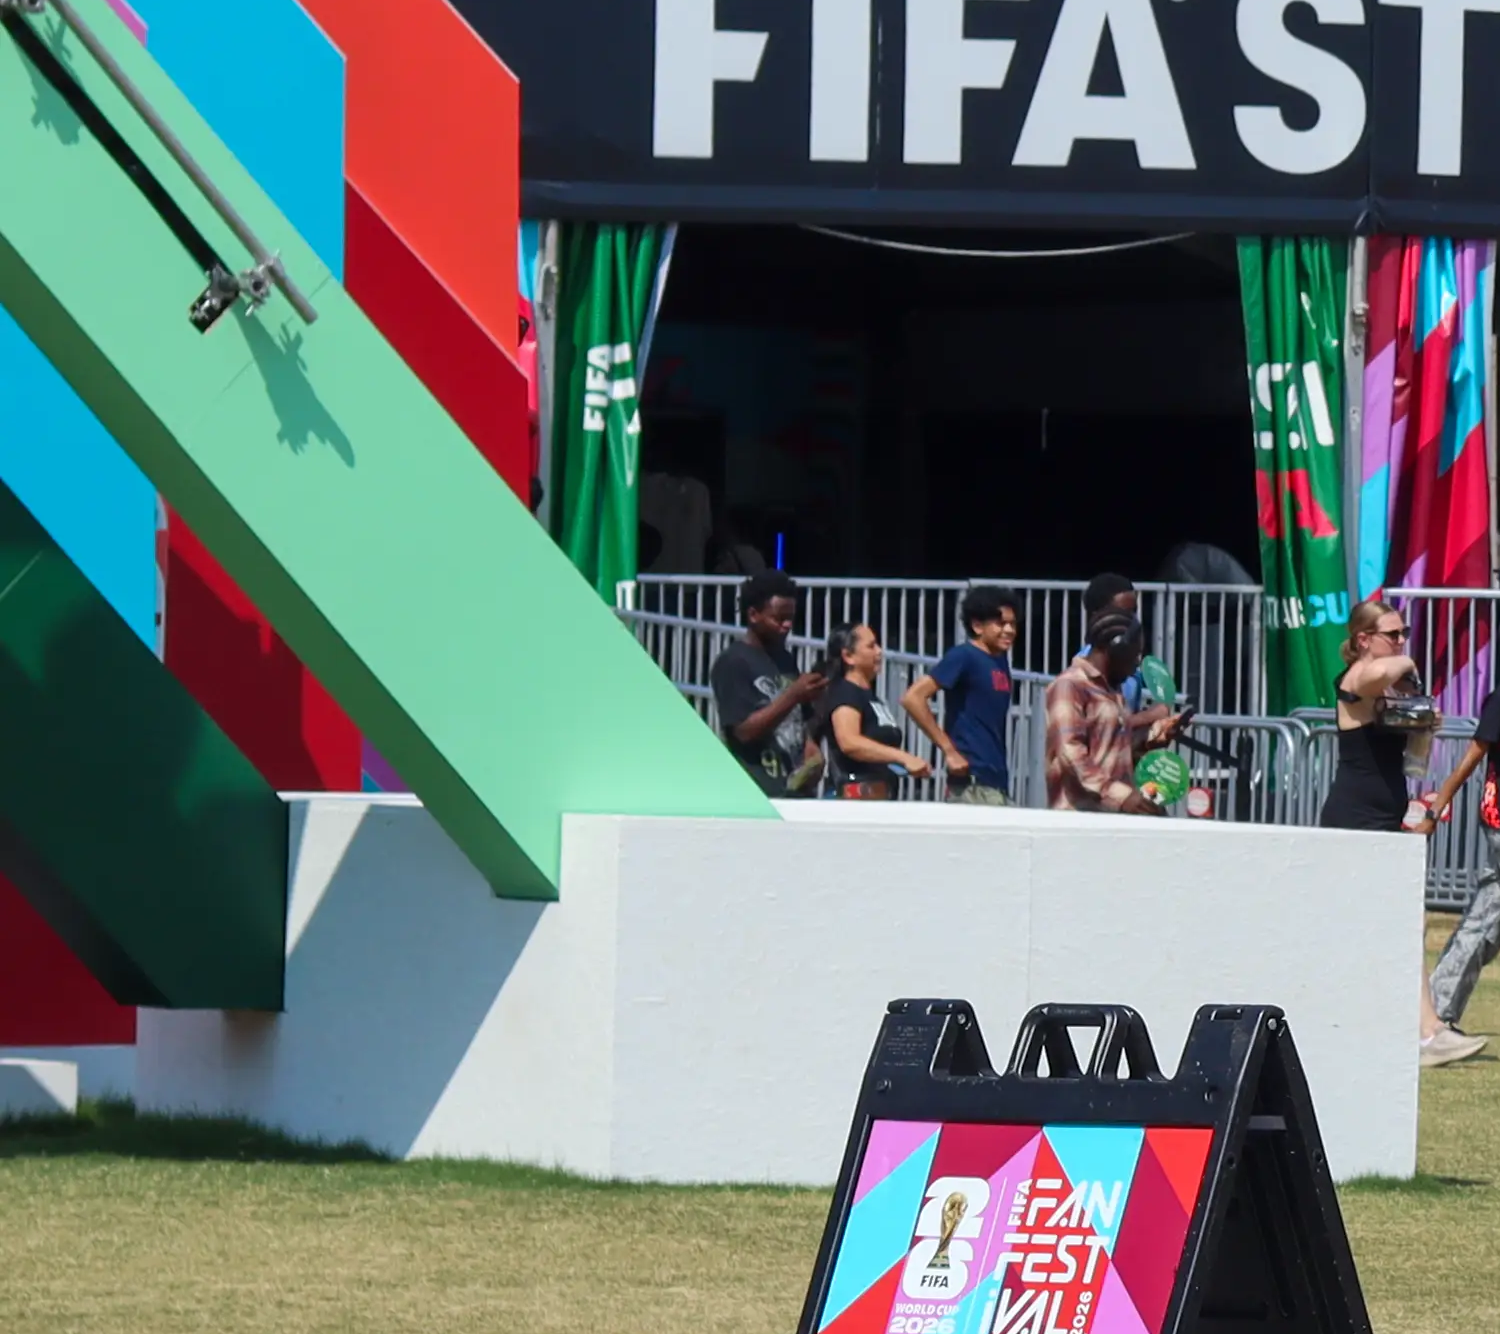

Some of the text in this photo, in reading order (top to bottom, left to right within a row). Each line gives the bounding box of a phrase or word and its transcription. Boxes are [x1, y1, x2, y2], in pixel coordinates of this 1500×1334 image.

[583, 343, 612, 432] FIFA
[1007, 1178, 1033, 1227] FIFA
[1025, 1178, 1124, 1229] FAN
[920, 1274, 950, 1289] FIFA
[993, 1233, 1111, 1284] FEST
[895, 1303, 960, 1316] WORLD CUP
